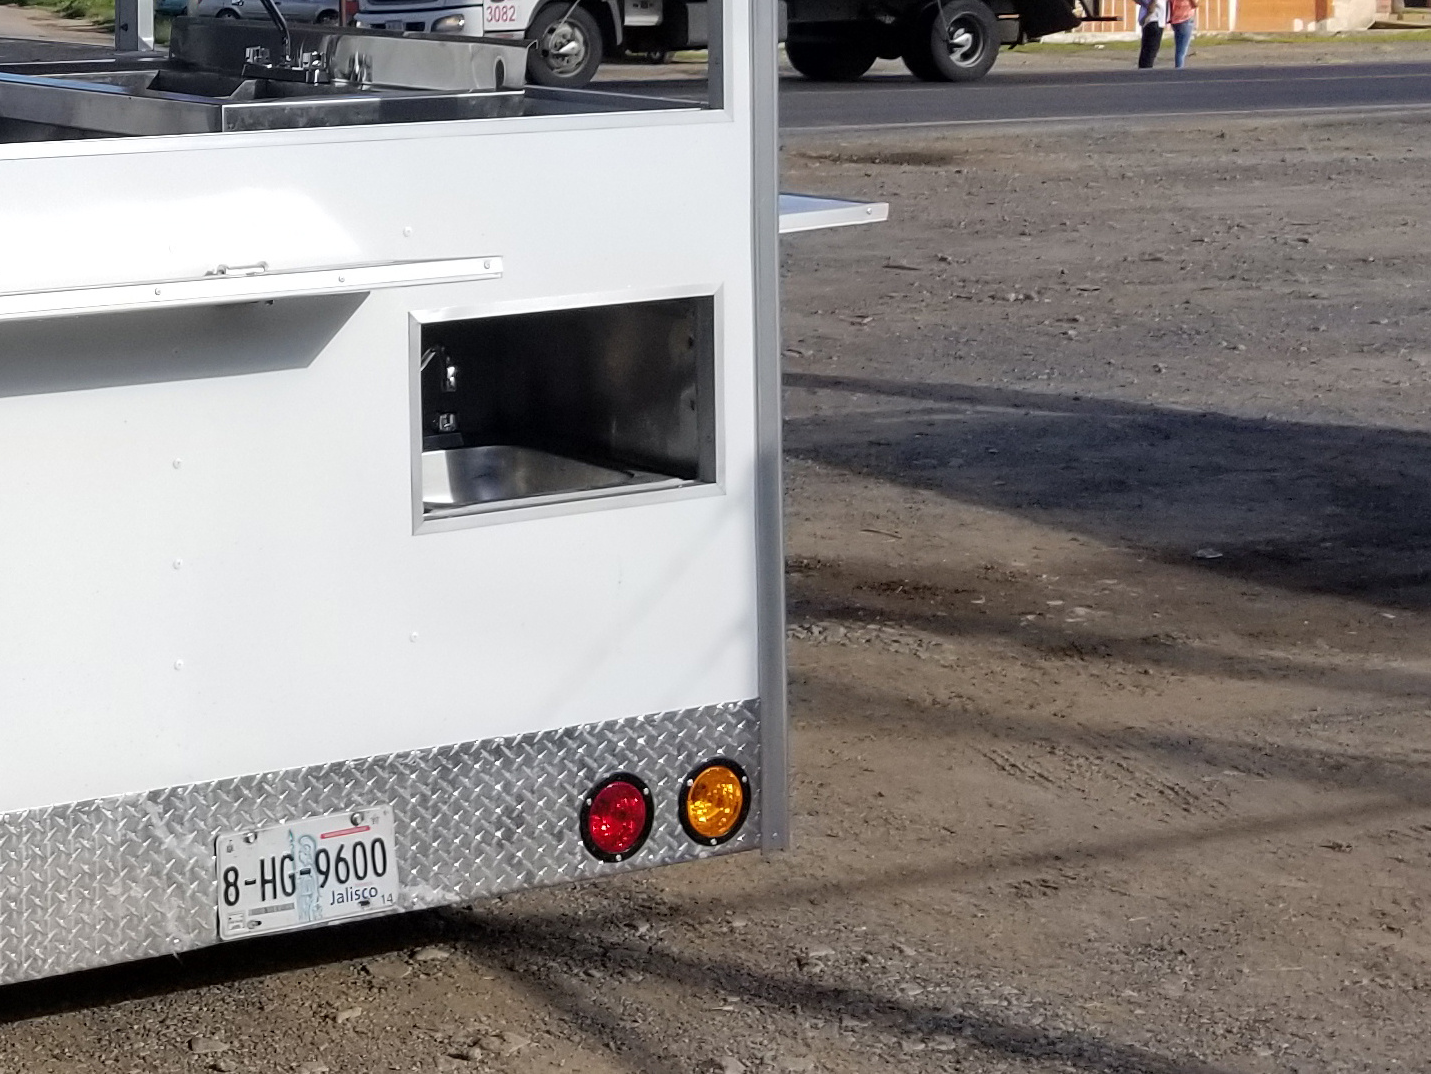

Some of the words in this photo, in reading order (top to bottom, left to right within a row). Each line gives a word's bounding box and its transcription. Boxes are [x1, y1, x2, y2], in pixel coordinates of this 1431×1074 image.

[486, 5, 516, 23] 3082
[223, 837, 387, 906] 8-HG-9600
[330, 886, 378, 906] Jalisco
